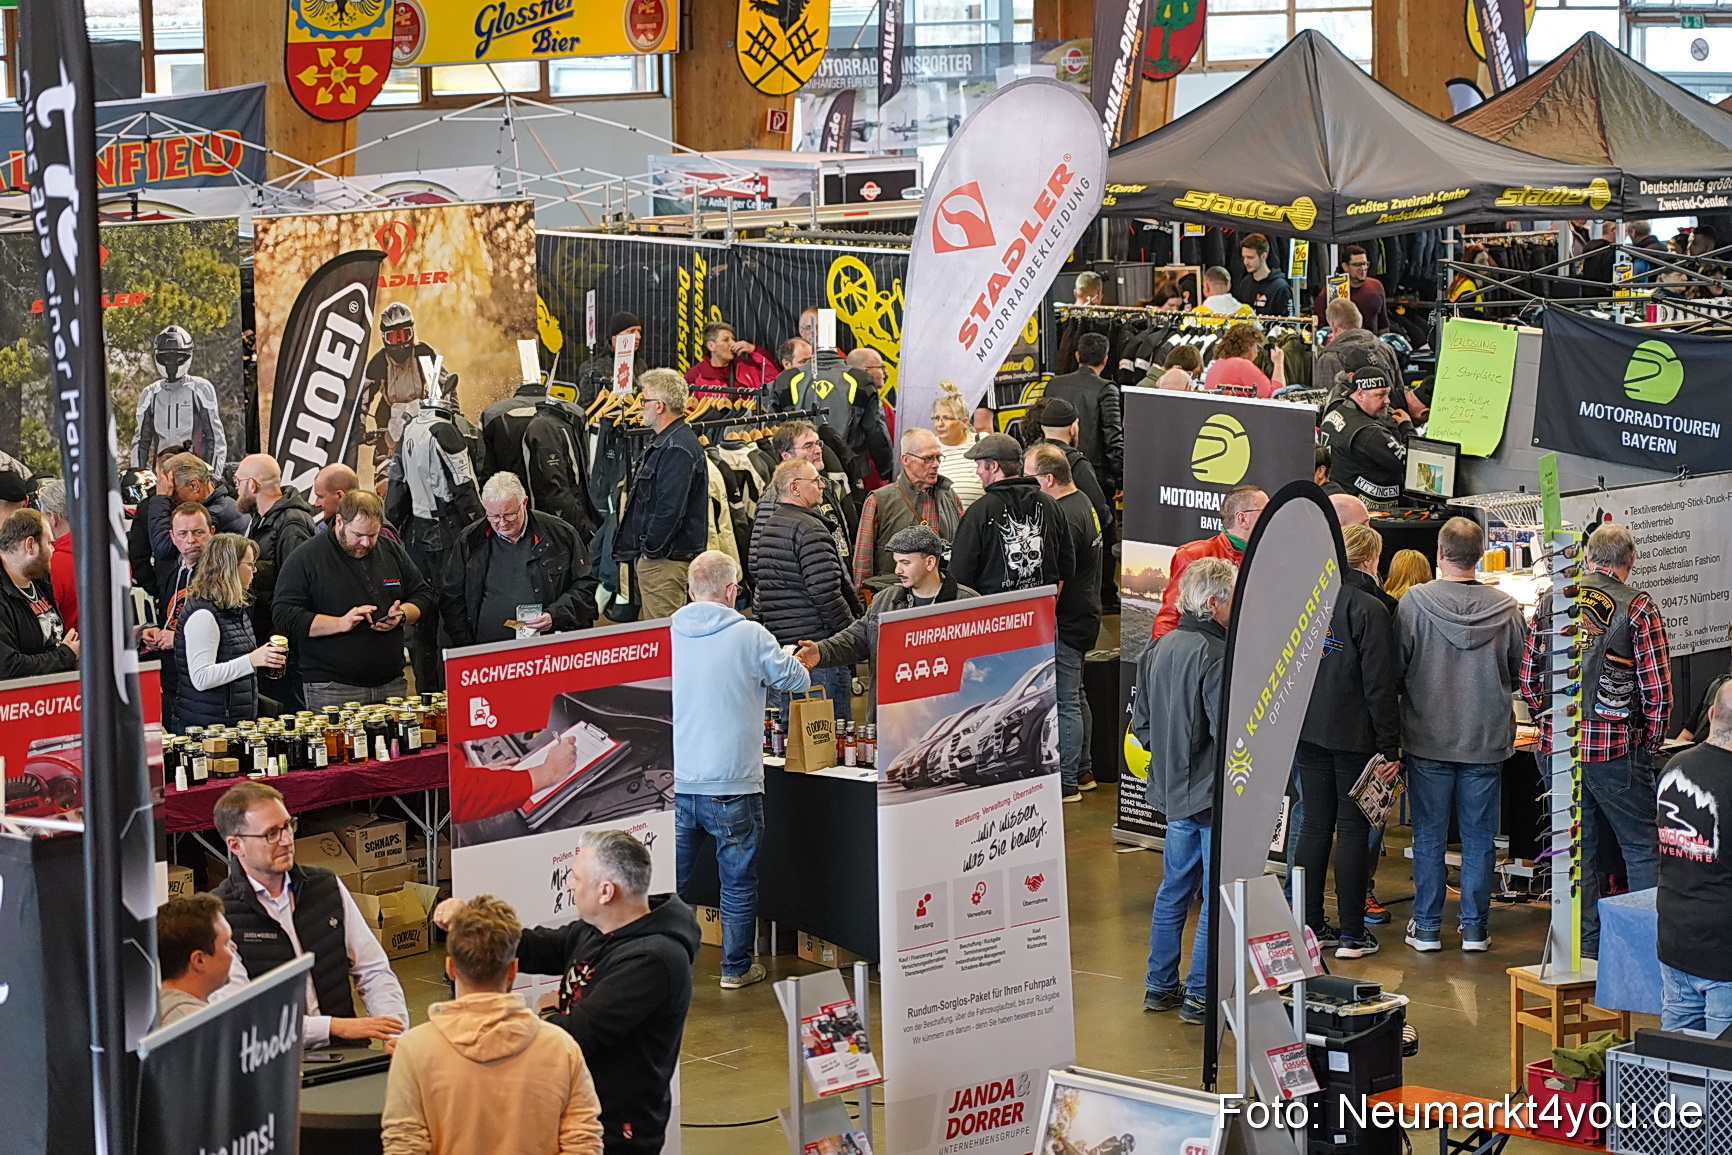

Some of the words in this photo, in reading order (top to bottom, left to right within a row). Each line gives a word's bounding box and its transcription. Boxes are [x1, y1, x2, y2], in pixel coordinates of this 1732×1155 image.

[474, 0, 575, 59] Glossner
[532, 27, 581, 55] Bier
[96, 129, 243, 190] NFIELD
[1640, 179, 1705, 195] Deutschlands
[1346, 197, 1388, 216] Größtes
[1391, 188, 1470, 210] Zweirad-Center
[1657, 195, 1729, 212] Zweirad-Center
[977, 177, 1090, 362] MOTORRADBEKLEIDUNG
[1449, 333, 1497, 350] VERLOSUNG
[1441, 367, 1451, 380] 2
[1468, 393, 1491, 410] Rallye
[1579, 401, 1721, 438] MOTORRADTOUREN
[1432, 427, 1463, 439] Vogtland
[1622, 431, 1677, 455] BAYERN
[1356, 476, 1400, 497] KITZINGEN
[1630, 516, 1674, 531] Textilvertrieb
[1652, 545, 1688, 558] Collection
[1631, 562, 1657, 576] Scippis
[1659, 558, 1694, 572] Australian
[1695, 554, 1721, 567] Fashion
[1632, 573, 1699, 590] Outdoorbekleidung
[1589, 591, 1612, 610] CHAPTER
[1661, 596, 1689, 609] 90475
[1690, 589, 1730, 602] Nürnberg
[904, 611, 1035, 648] FUHRPARKMANAGEMENT
[1694, 626, 1709, 636] nach
[1246, 557, 1336, 736] KURZENDORFER
[460, 642, 659, 687] SACHVERSTÄNDIGENBEREICH
[954, 811, 982, 828] Beratung.
[981, 796, 1012, 816] Verwaltung.
[1012, 782, 1045, 802] Übernahme.
[364, 833, 402, 853] SCHNAPS.
[988, 838, 1007, 861] Sie
[374, 850, 386, 859] KEIN
[552, 851, 574, 865] Prüfen.
[1022, 897, 1049, 908] Übernahme
[967, 908, 992, 919] Verwaltung
[913, 920, 934, 931] Beratung
[959, 939, 982, 950] Beschaffung
[984, 936, 1002, 945] Rückgabe
[1026, 934, 1047, 943] Verwaltung
[1026, 941, 1048, 950] Rücknahme
[898, 955, 909, 963] Kauf
[1268, 947, 1295, 960] Classics
[907, 990, 991, 1019] Rundum-Sorglos-Paket
[992, 987, 1003, 998] für
[1003, 984, 1023, 997] Ihren
[1024, 976, 1057, 992] Fuhrpark
[903, 1025, 913, 1033] von
[914, 1022, 923, 1031] der
[954, 1011, 967, 1021] über
[967, 1009, 976, 1018] die
[1018, 998, 1026, 1007] bis
[1026, 997, 1035, 1005] zur
[912, 1035, 922, 1045] Wir
[922, 1031, 945, 1042] kümmern
[945, 1028, 955, 1037] uns
[955, 1025, 972, 1036] darum
[975, 1021, 988, 1031] denn
[989, 1018, 998, 1027] Sie
[998, 1015, 1014, 1026] haben
[1014, 1011, 1037, 1022] besseres
[1282, 1059, 1309, 1072] Classics
[948, 1078, 1015, 1114] JANDA
[946, 1101, 1025, 1140] DORRER
[232, 1112, 275, 1155] uns!
[939, 1126, 1031, 1155] UNTERNEHMENSGRUPPE
